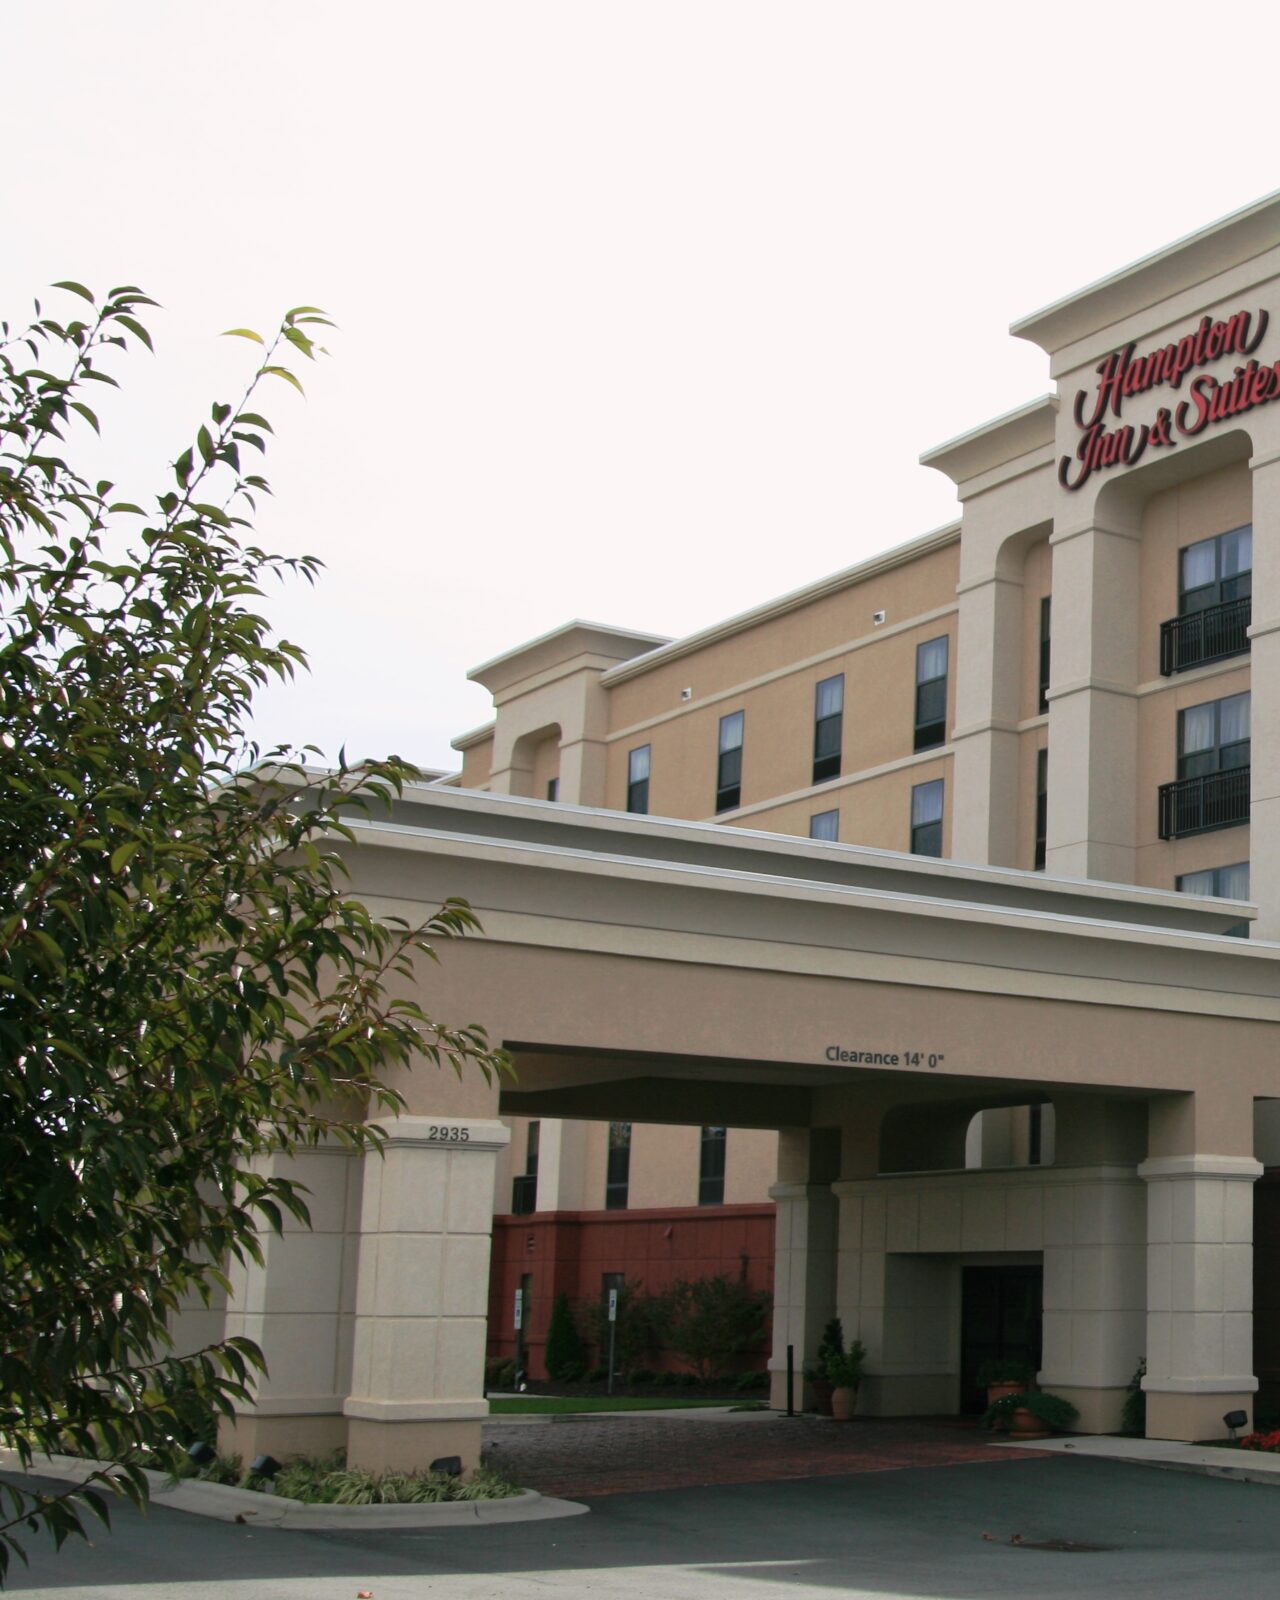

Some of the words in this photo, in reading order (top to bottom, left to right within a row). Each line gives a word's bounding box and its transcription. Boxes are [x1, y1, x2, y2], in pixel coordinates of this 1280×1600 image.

[1073, 308, 1269, 430] Hampton
[1058, 422, 1149, 491] Inn
[1148, 407, 1177, 447] &
[825, 1046, 899, 1066] Clearance
[903, 1051, 925, 1067] 14'
[928, 1053, 945, 1068] 0"
[428, 1125, 470, 1142] 2935
